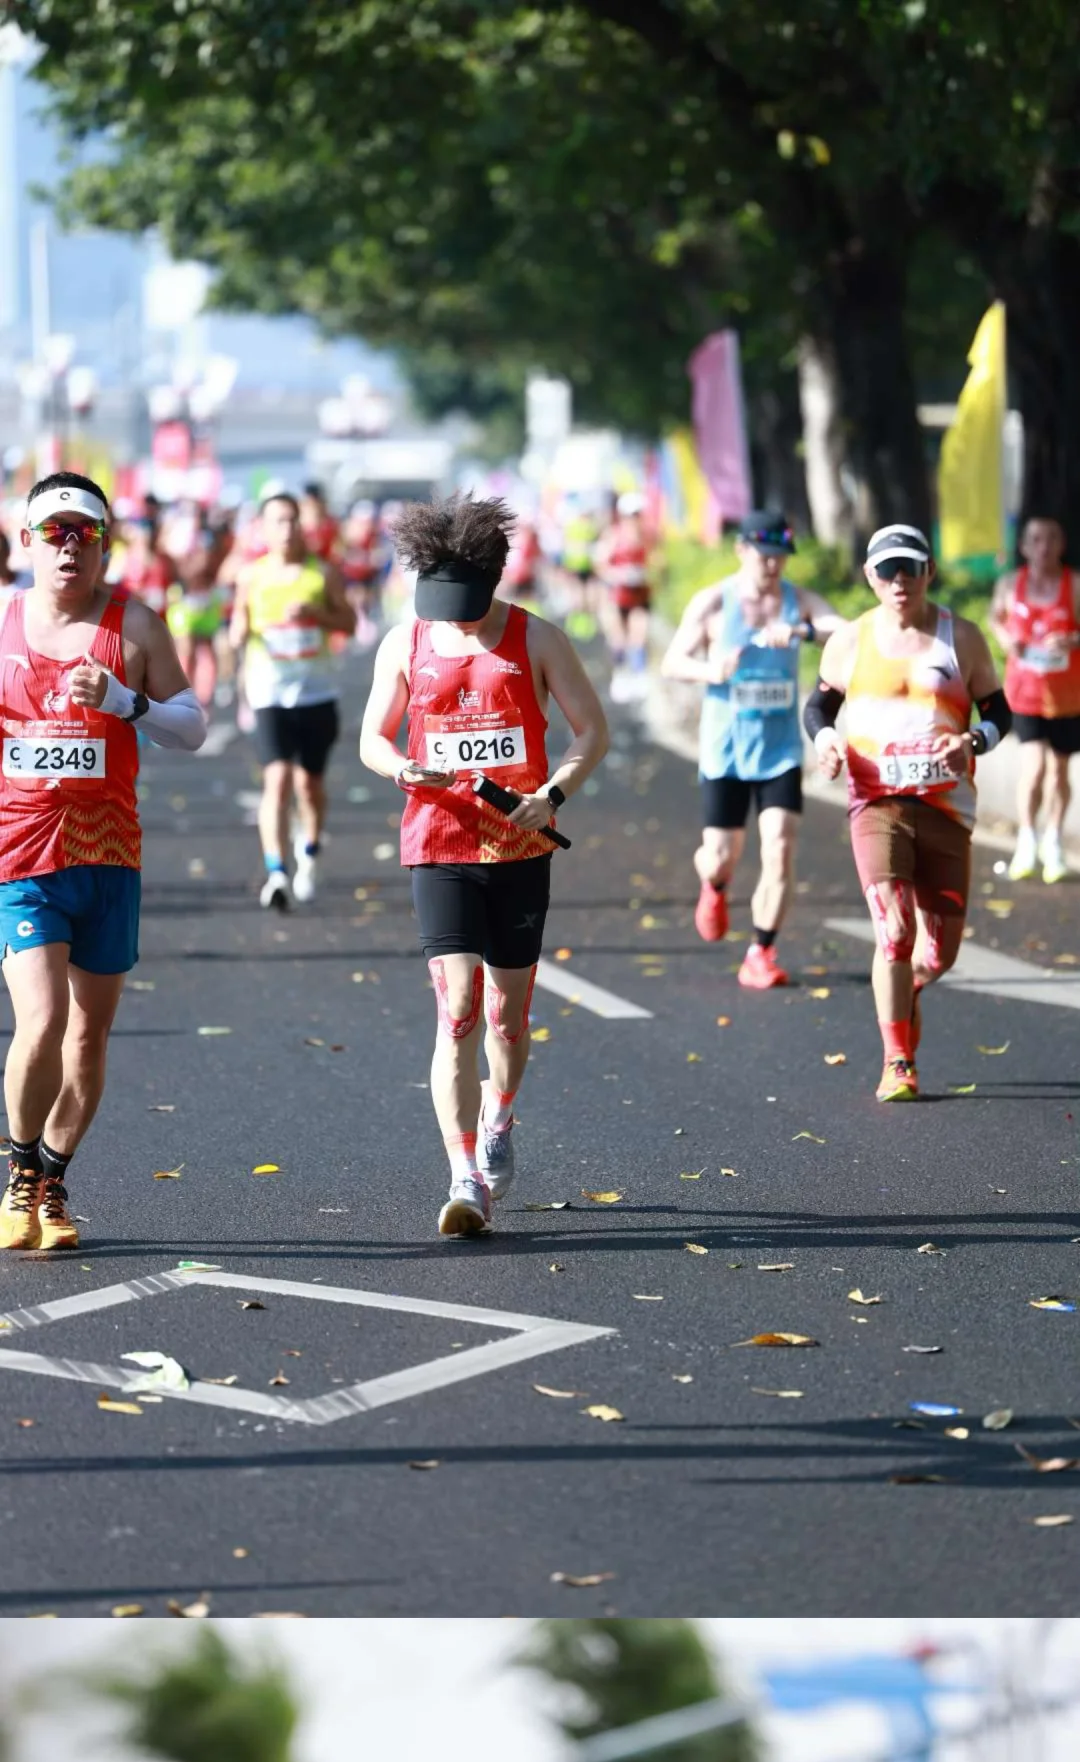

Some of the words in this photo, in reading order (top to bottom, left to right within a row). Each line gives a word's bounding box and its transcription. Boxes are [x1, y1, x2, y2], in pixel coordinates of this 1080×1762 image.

[9, 747, 21, 761] C
[34, 747, 97, 771] 2349
[434, 742, 444, 755] C
[458, 737, 516, 762] 0216
